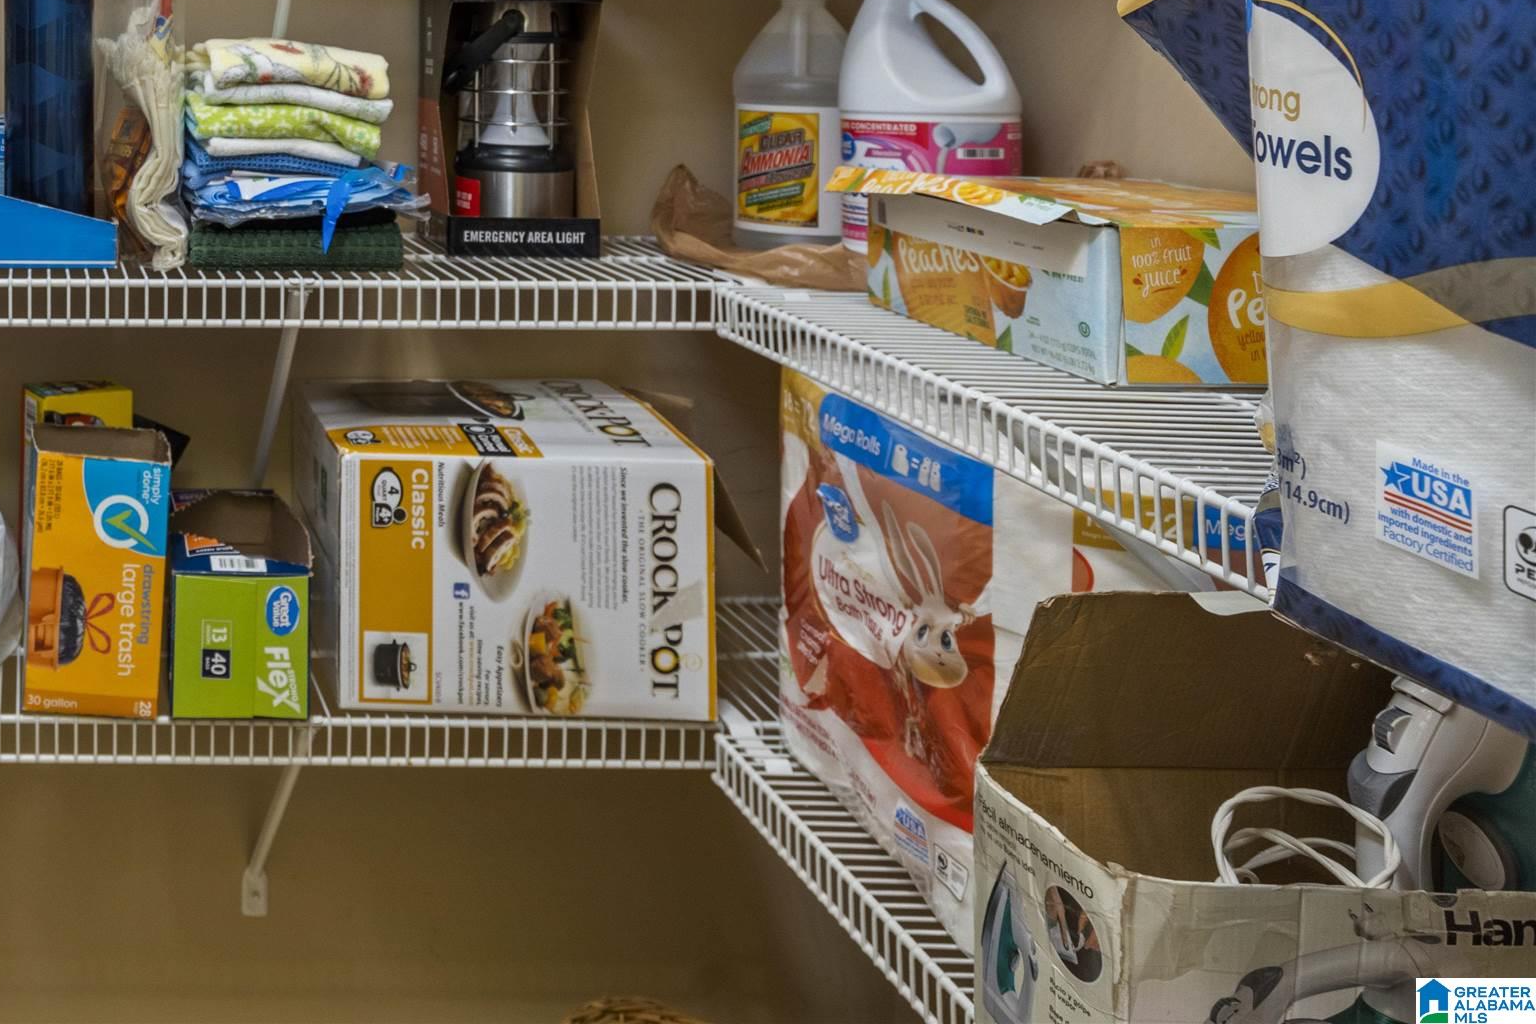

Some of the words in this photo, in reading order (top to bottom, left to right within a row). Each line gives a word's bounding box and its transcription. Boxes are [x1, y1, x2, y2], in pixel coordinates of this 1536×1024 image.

[758, 129, 806, 147] CLEAR
[851, 121, 917, 133] CONCENTRATED
[740, 141, 812, 174] AMMONIA
[464, 230, 525, 244] EMERGENCY
[527, 231, 554, 244] AREA
[555, 231, 586, 244] LIGHT
[1131, 251, 1161, 269] 100%
[1162, 244, 1194, 264] fruit
[1150, 235, 1161, 249] in
[1140, 265, 1184, 298] juice
[823, 414, 855, 444] Mega
[855, 430, 882, 457] Rolls
[151, 466, 161, 505] simply
[387, 482, 400, 496] 4
[437, 461, 445, 505] Nutritious
[1412, 456, 1440, 476] Made
[1441, 466, 1450, 480] in
[1452, 469, 1470, 487] the
[411, 466, 426, 551] Classic
[1410, 471, 1472, 518] USA
[438, 506, 446, 528] Meals
[1377, 511, 1420, 537] imported
[1420, 525, 1473, 558] ingredients
[1390, 504, 1410, 522] with
[1411, 512, 1451, 537] domestic
[1453, 528, 1473, 545] and
[638, 536, 647, 587] ORIGINAL
[648, 481, 682, 615] CROCK
[1383, 525, 1424, 554] Factory
[1425, 544, 1474, 573] Certified
[116, 562, 135, 621] large
[137, 563, 154, 645] drawstring
[274, 590, 292, 629] Great
[639, 589, 647, 619] SLOW
[818, 554, 850, 594] Ultra
[854, 577, 907, 638] Strong
[211, 625, 228, 644] 13
[270, 600, 282, 629] Value
[117, 624, 135, 677] trash
[210, 652, 228, 675] 40
[639, 622, 647, 666] COOKER
[650, 623, 684, 700] POT
[255, 644, 302, 715] Flex
[495, 663, 504, 708] Appetizers
[27, 693, 42, 707] 30
[42, 694, 78, 710] gallon
[138, 700, 152, 718] 28
[998, 817, 1094, 900] almacenamiento
